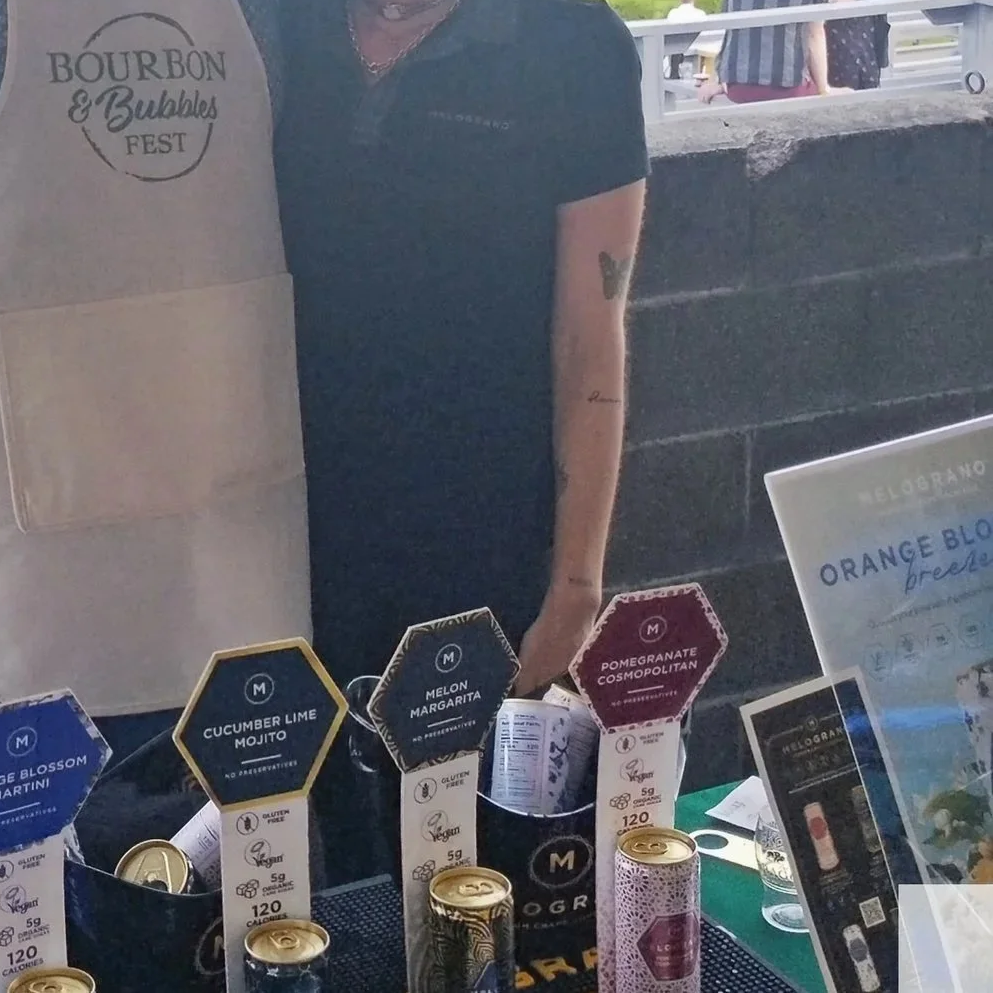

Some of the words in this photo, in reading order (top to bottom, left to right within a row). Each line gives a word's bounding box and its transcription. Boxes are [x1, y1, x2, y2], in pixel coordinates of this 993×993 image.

[46, 48, 227, 84] BOURBON
[67, 88, 93, 124] &
[94, 84, 218, 134] Bubbles
[124, 131, 187, 156] FEST
[819, 534, 935, 587] ORANGE
[601, 646, 698, 672] POMEGRANATE
[597, 660, 698, 686] COSMOPOLITAN
[426, 679, 468, 701] MELON
[410, 690, 482, 719] MARGARITA
[203, 716, 281, 739] CUCUMBER
[285, 709, 317, 725] LIME
[424, 720, 476, 739] PRESERVATIVES
[235, 730, 287, 749] MOJITO
[20, 755, 87, 780] BLOSSOM
[238, 760, 298, 776] PRESERVATIVES
[441, 770, 470, 784] GLUTEN
[446, 779, 465, 789] FREE
[641, 787, 655, 797] 5g
[262, 809, 290, 819] GLUTEN
[267, 816, 285, 824] FREE
[622, 811, 649, 827] 120
[429, 826, 460, 843] Vegan
[17, 853, 46, 866] GLUTEN
[252, 854, 285, 869] Vegan
[447, 849, 463, 862] 5g
[549, 850, 575, 874] M
[22, 861, 41, 870] FREE
[271, 873, 286, 883] 5g
[7, 897, 39, 914] Vegan
[251, 900, 282, 918] 120
[26, 917, 41, 928] 5g
[246, 912, 289, 928] CALORIES
[7, 945, 37, 966] 120
[2, 958, 44, 977] CALORIES
